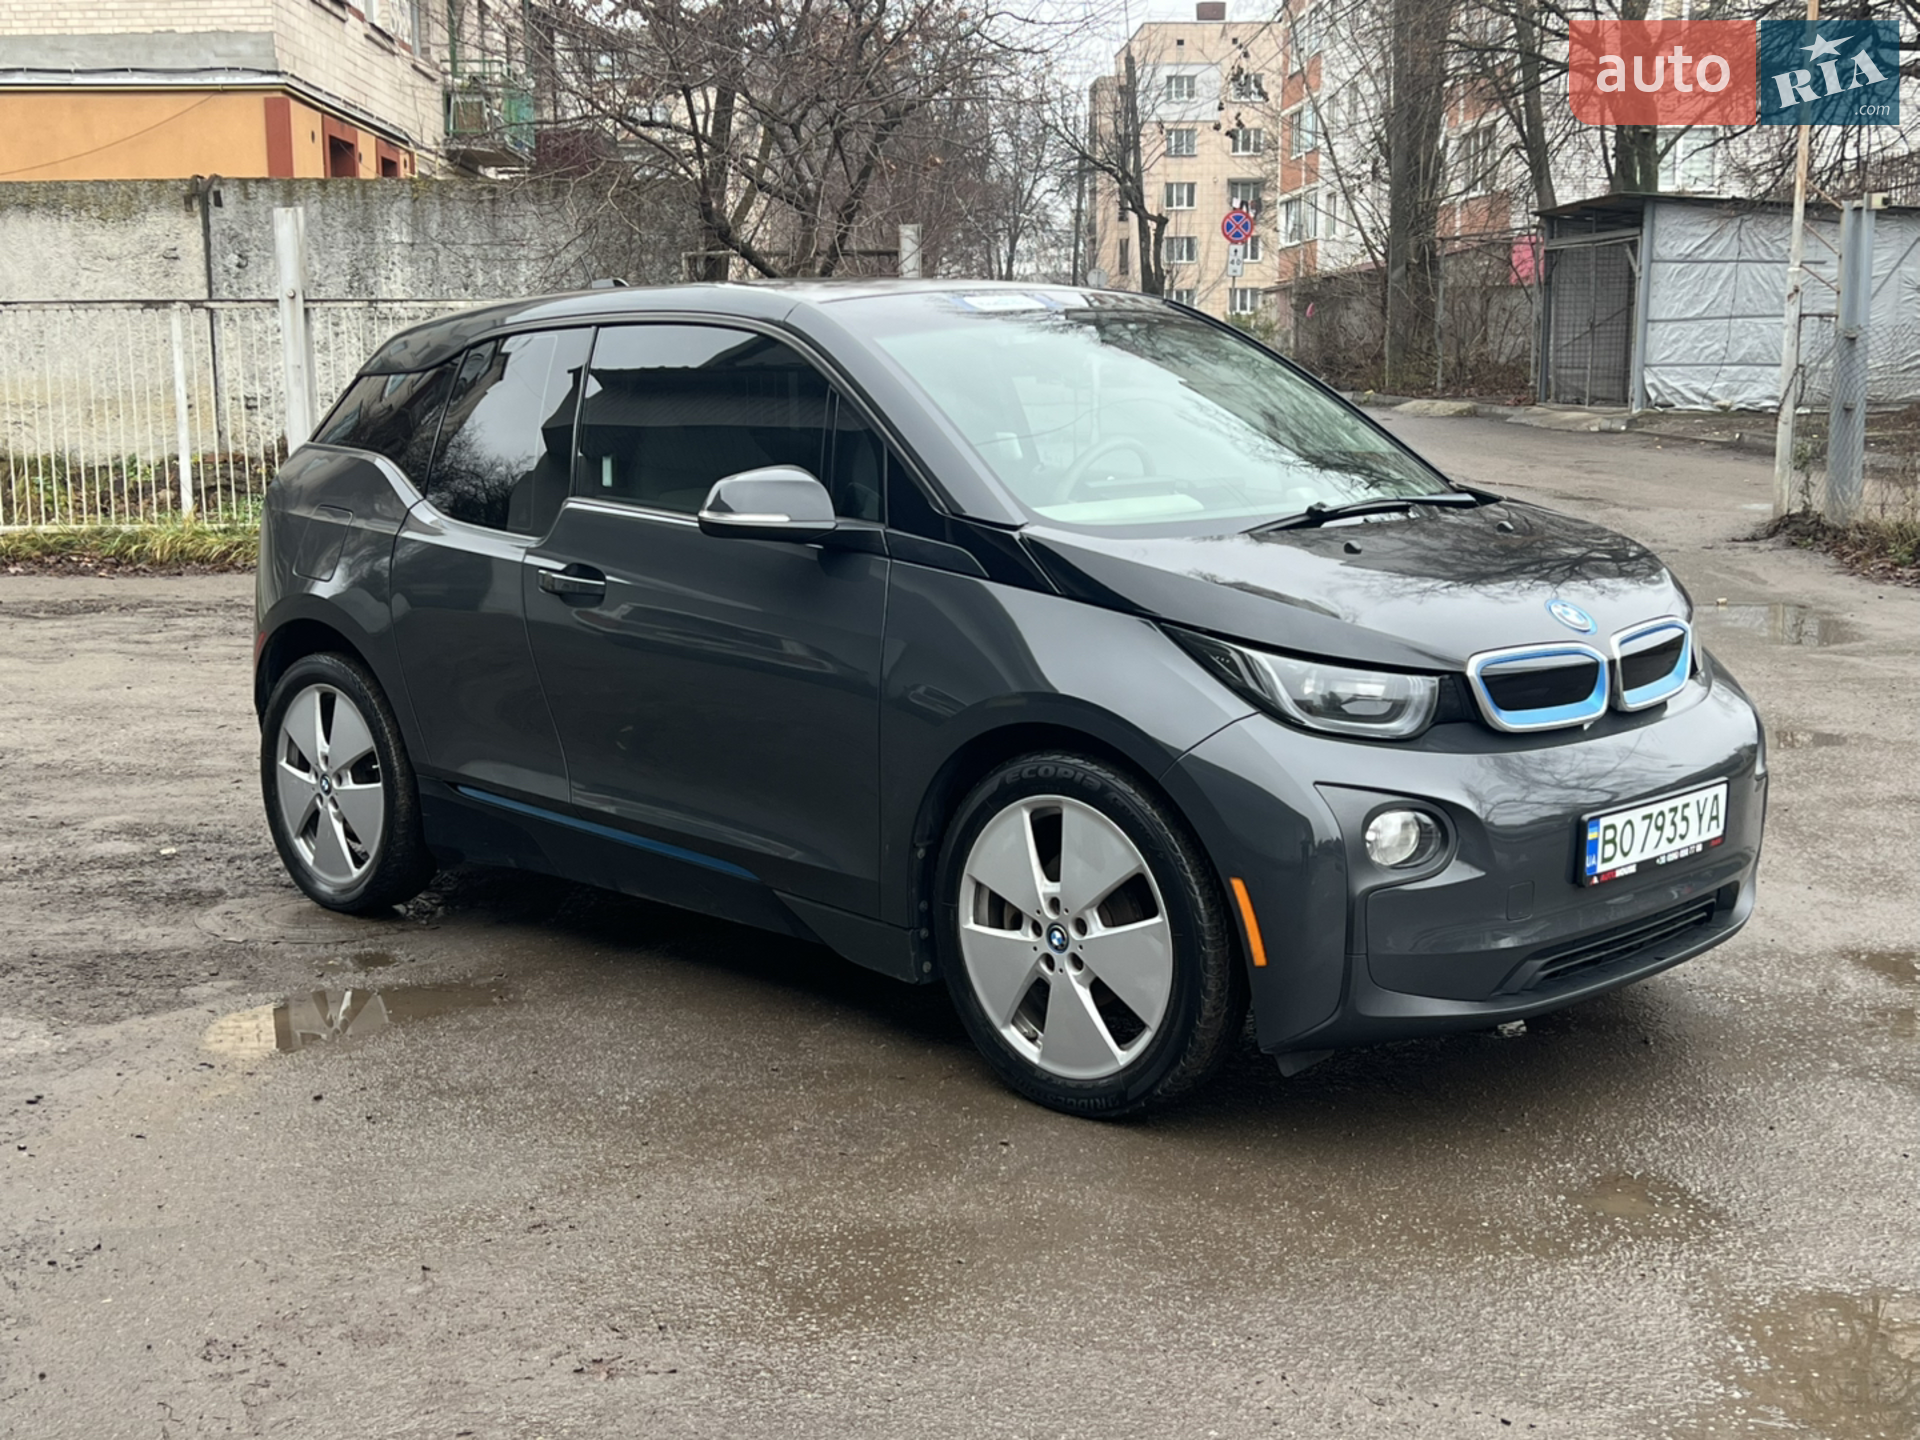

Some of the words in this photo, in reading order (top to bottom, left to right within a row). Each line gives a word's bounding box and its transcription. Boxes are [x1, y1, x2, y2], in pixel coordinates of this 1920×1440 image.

[1601, 819, 1635, 864] BO
[1639, 802, 1690, 854] 7935
[1696, 793, 1720, 837] YA
[1586, 853, 1597, 866] UA
